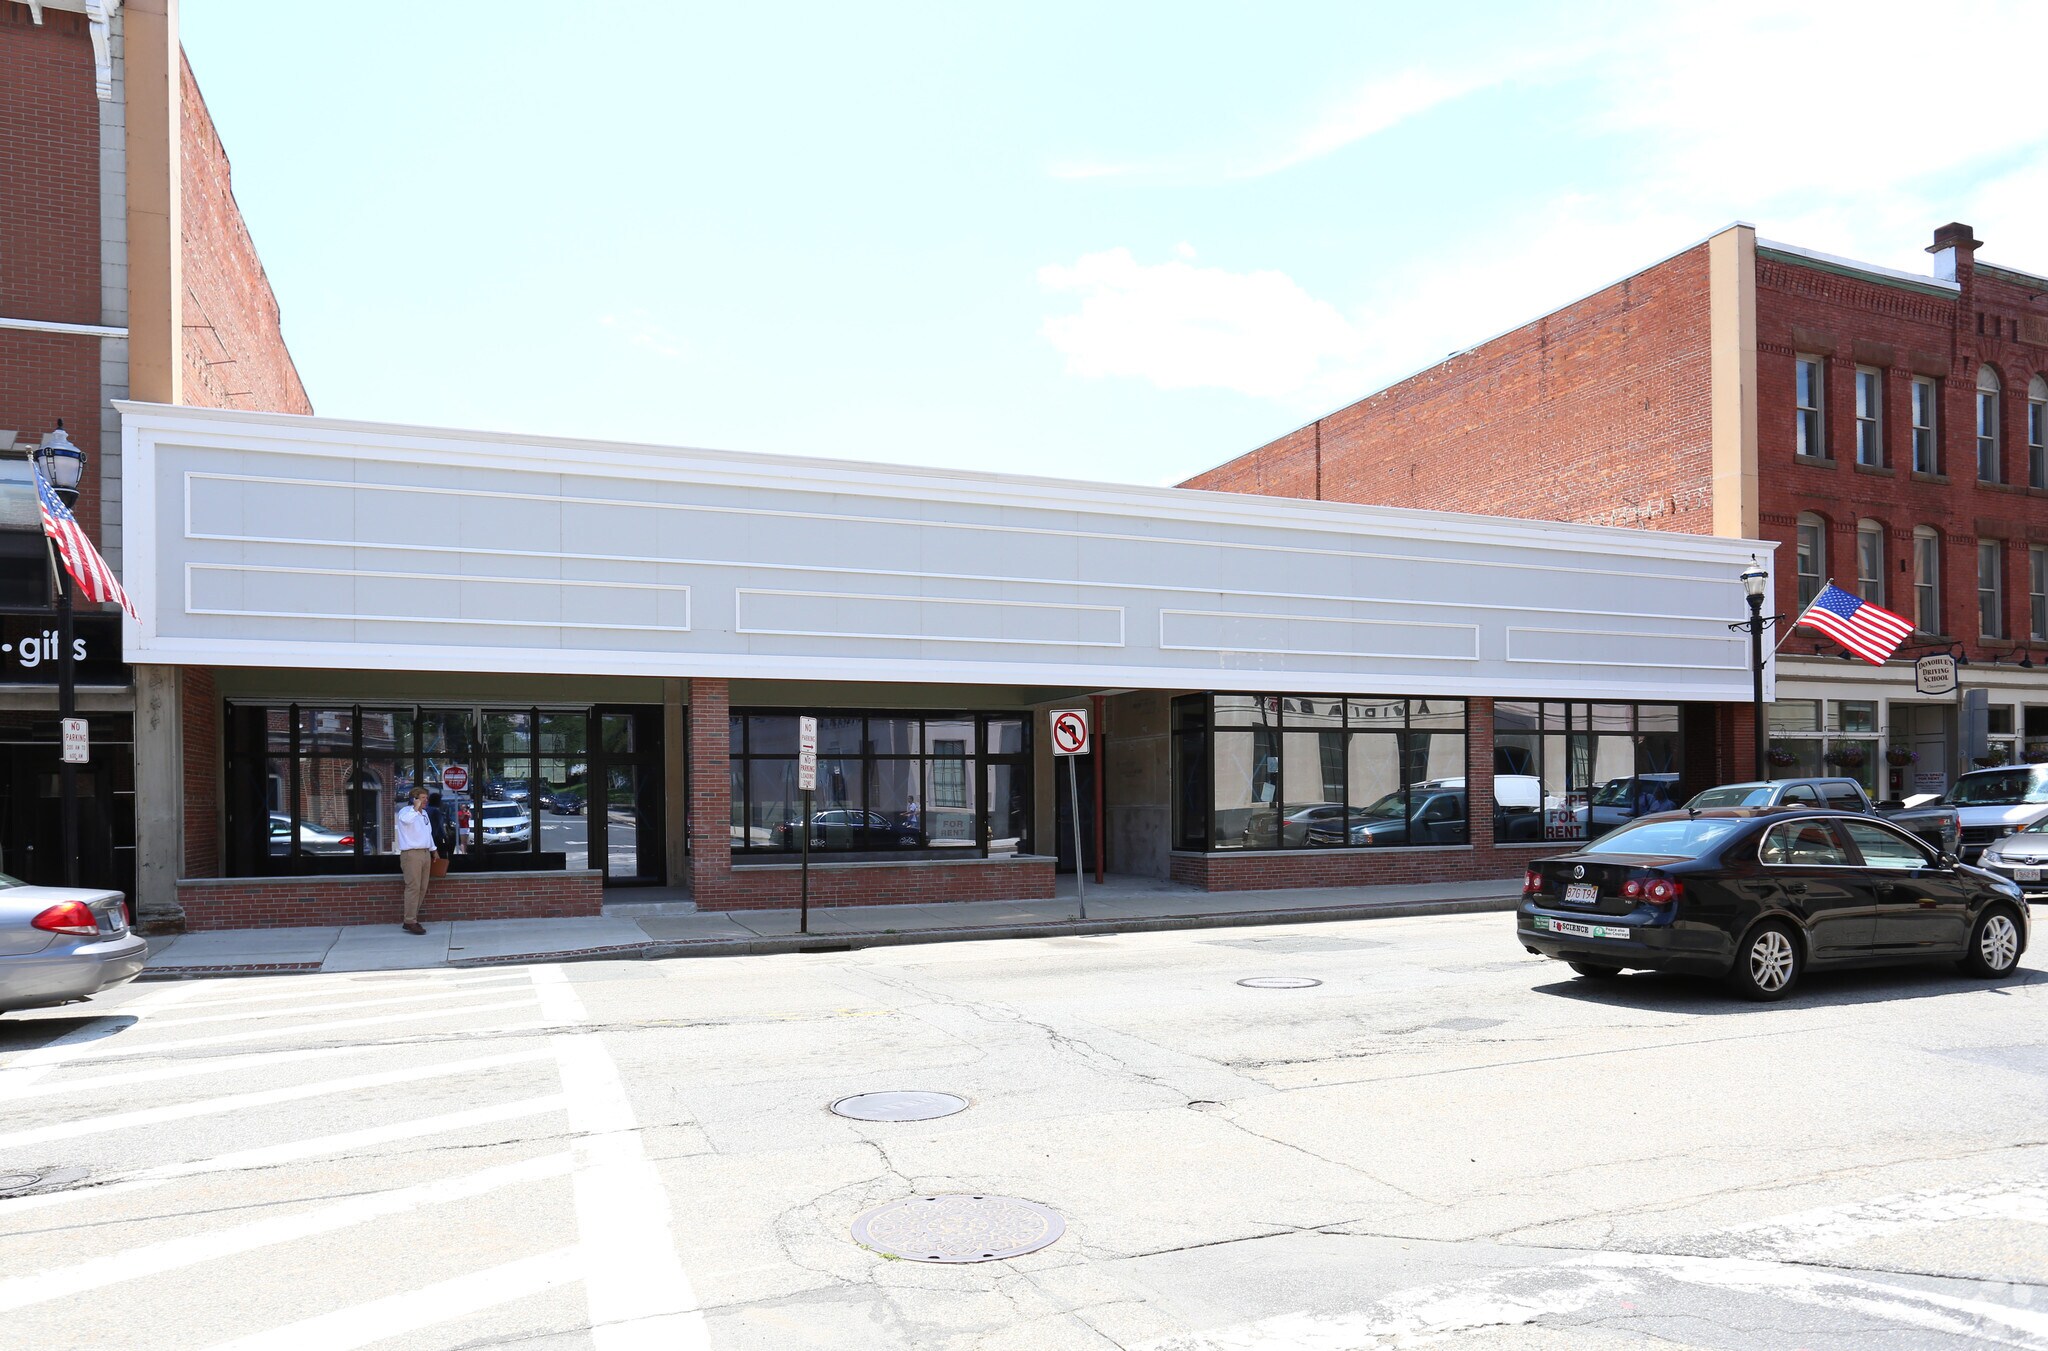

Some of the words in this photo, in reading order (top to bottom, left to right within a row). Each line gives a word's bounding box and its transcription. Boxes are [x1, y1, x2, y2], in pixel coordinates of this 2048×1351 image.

[19, 629, 87, 668] gifs
[1922, 668, 1949, 676] DRIVING
[1923, 675, 1949, 683] SCHOOL
[71, 722, 80, 731] NO
[804, 724, 812, 732] NO
[66, 733, 86, 742] PARKING
[800, 765, 815, 773] PARKING
[1550, 810, 1578, 823] FOR
[943, 820, 964, 828] FOR
[941, 829, 965, 837] RENT
[1545, 825, 1582, 838] RENT
[1567, 887, 1581, 899] 87G
[1582, 889, 1597, 900] T94
[1562, 922, 1589, 934] SCIENCE
